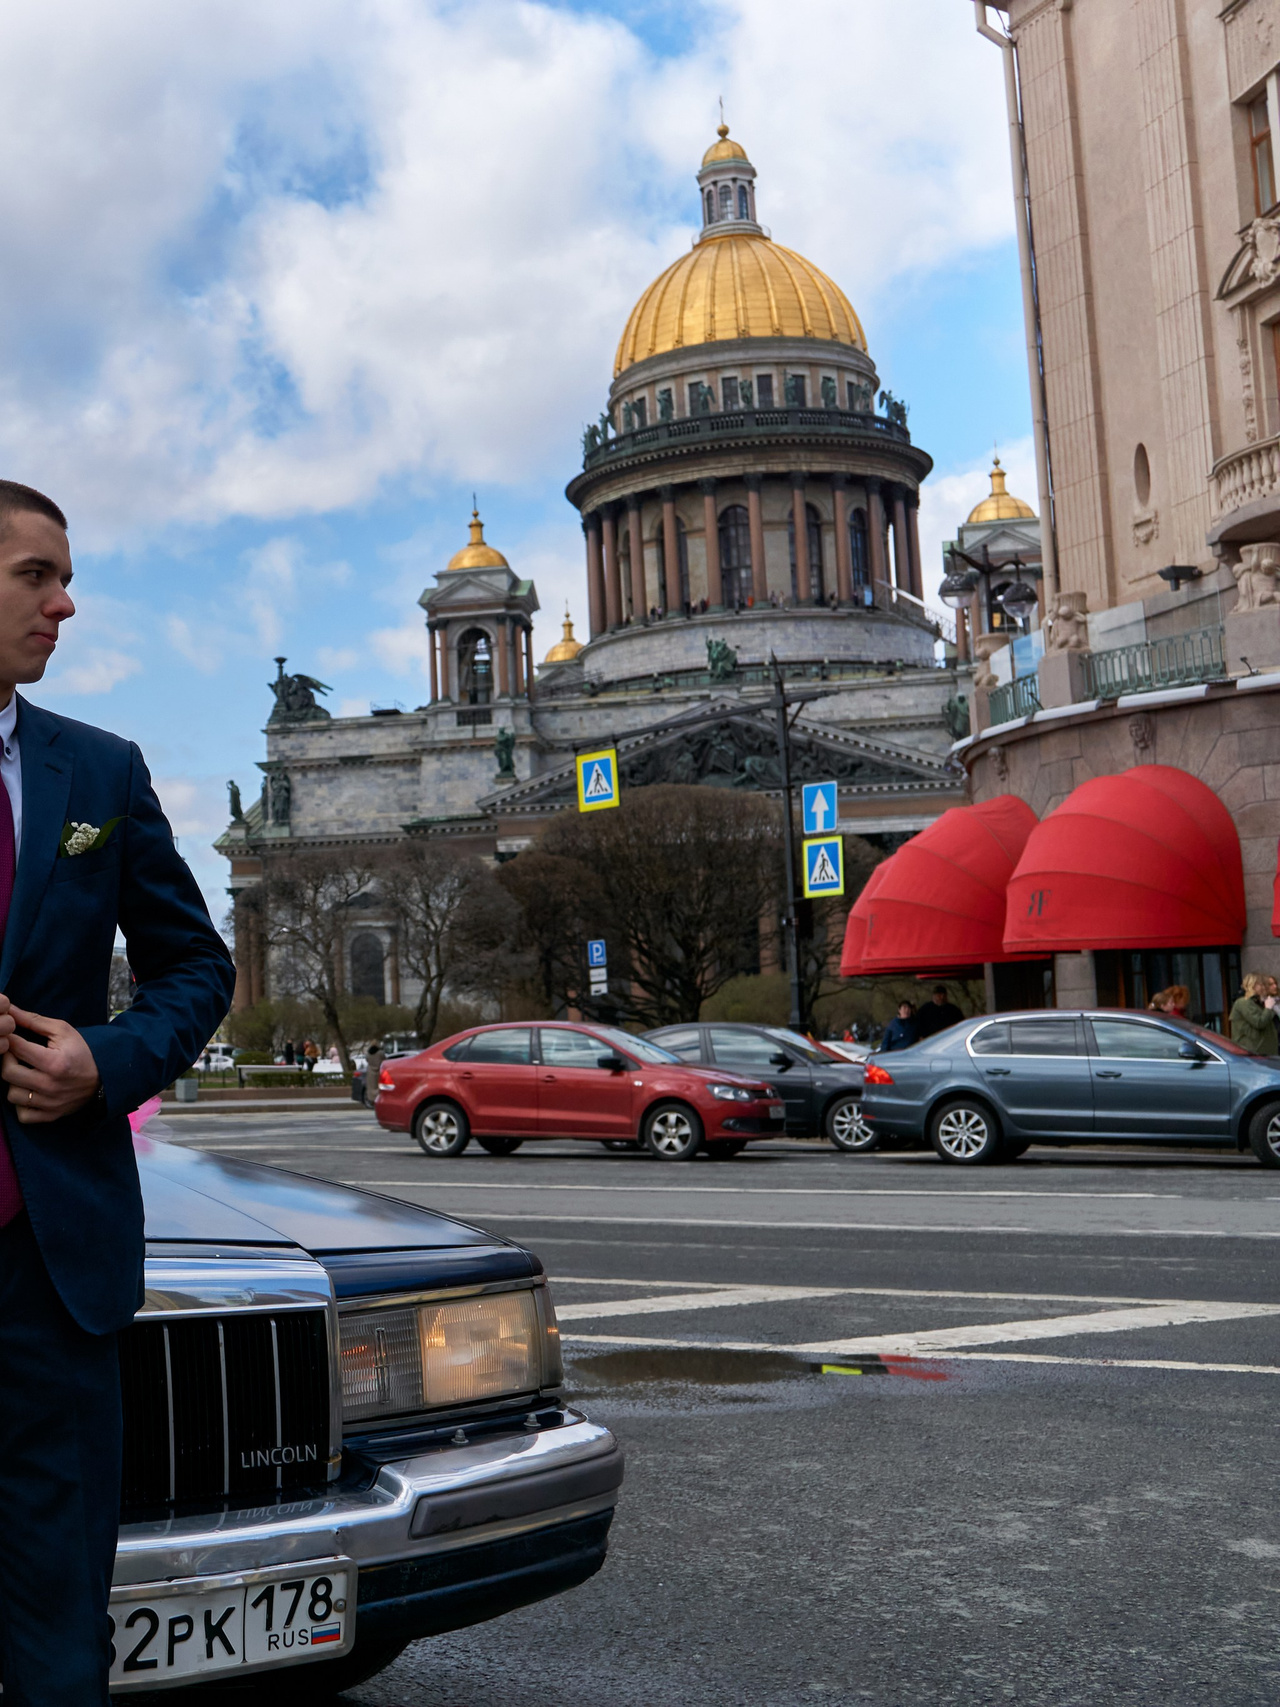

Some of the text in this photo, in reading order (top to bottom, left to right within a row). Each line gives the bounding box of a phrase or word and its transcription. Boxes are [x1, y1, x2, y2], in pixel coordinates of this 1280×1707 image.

[241, 1444, 317, 1468] LINCOLN
[251, 1577, 333, 1631] 178
[107, 1606, 236, 1672] 2PK
[268, 1629, 309, 1651] RUS
